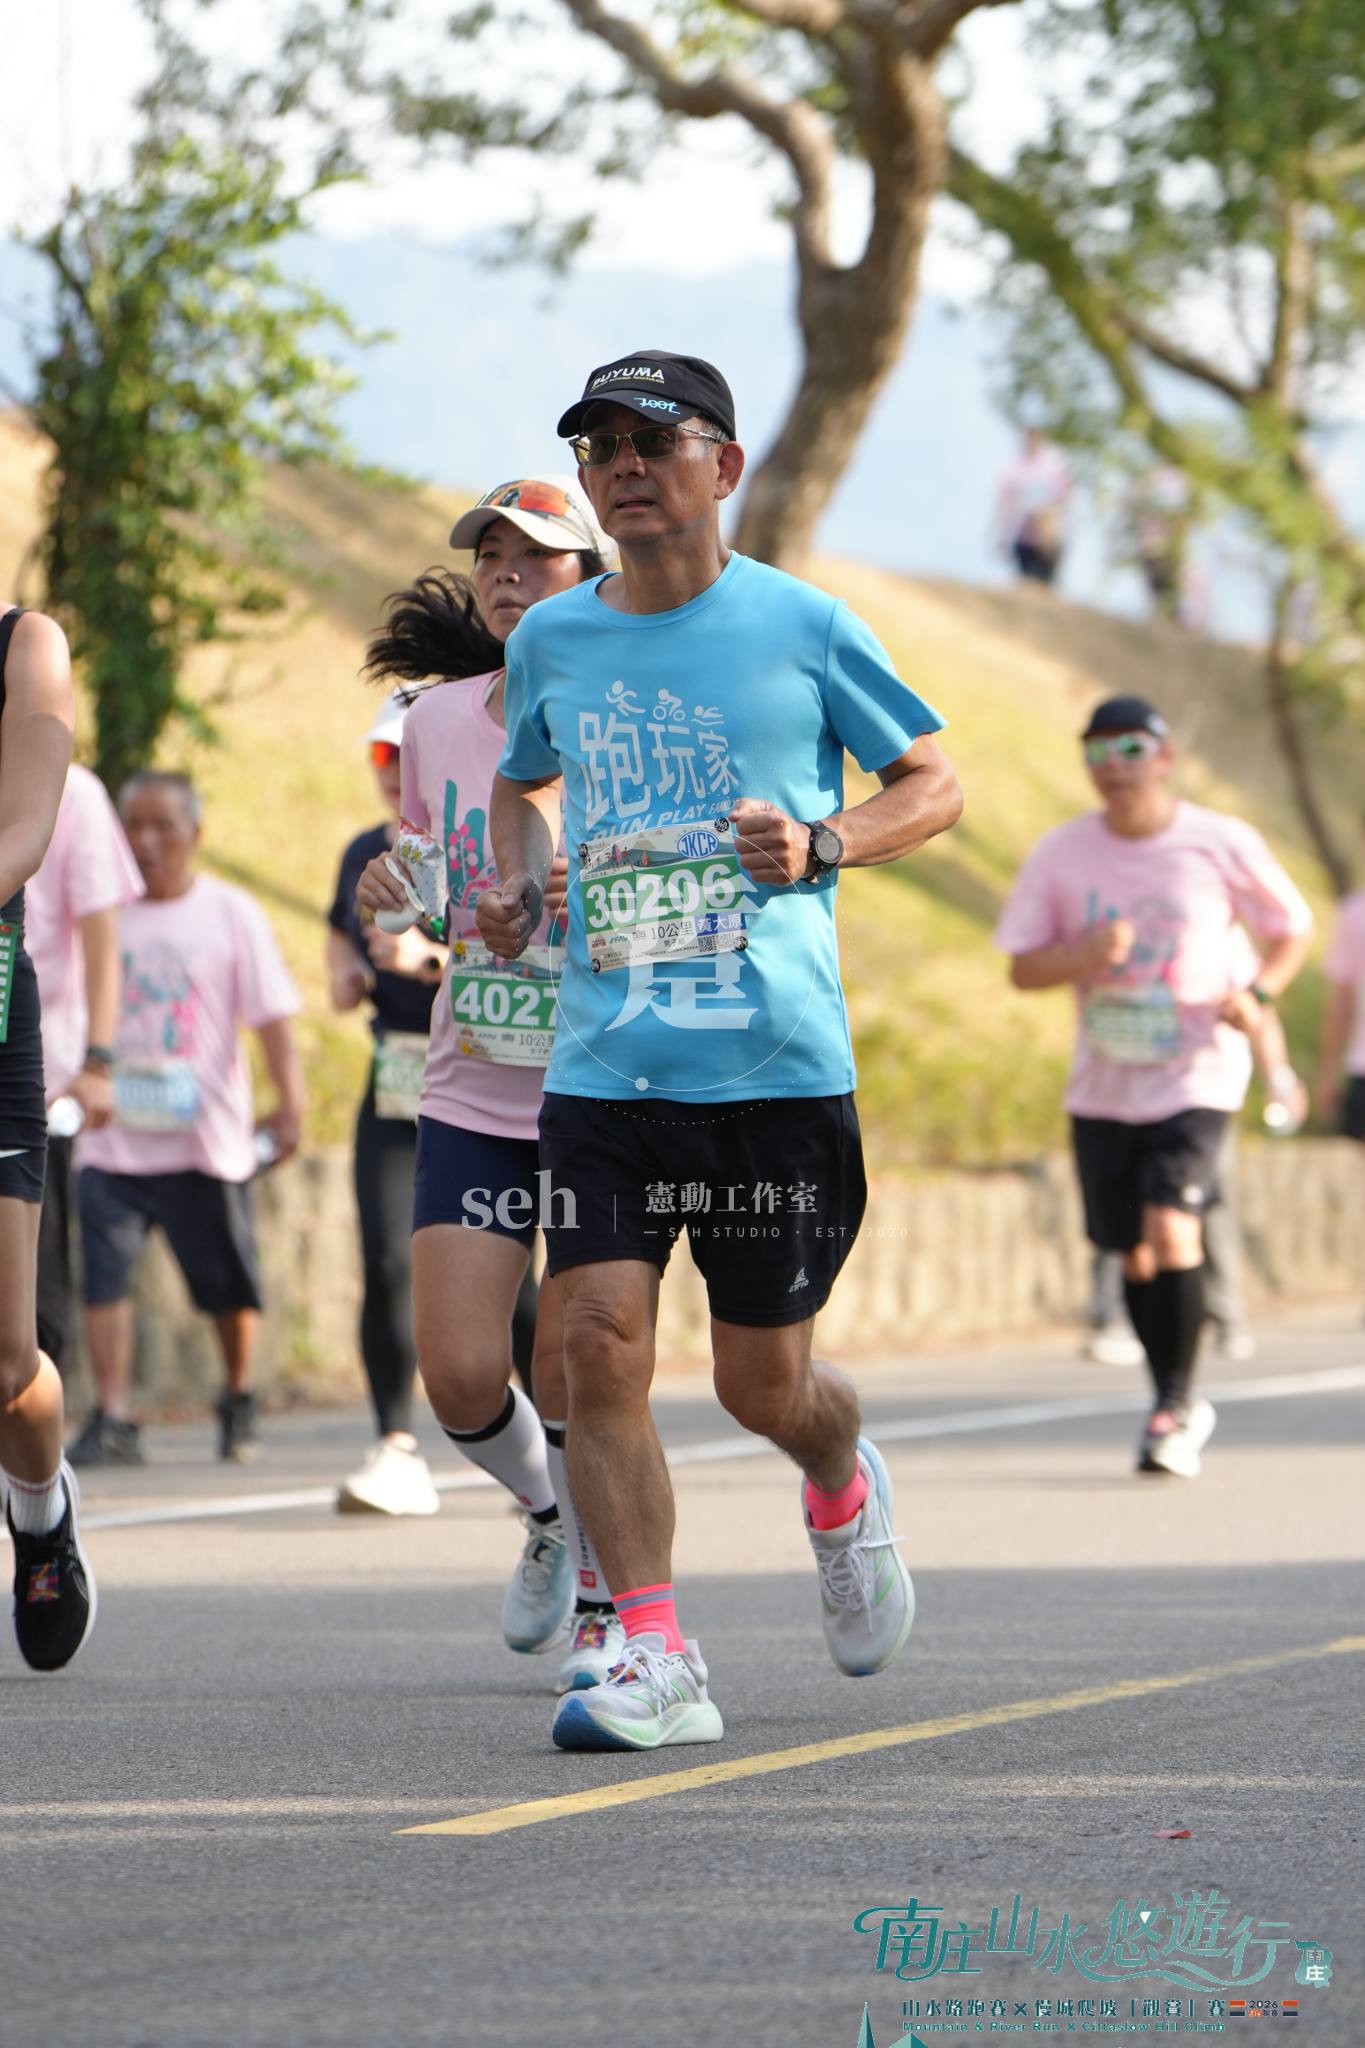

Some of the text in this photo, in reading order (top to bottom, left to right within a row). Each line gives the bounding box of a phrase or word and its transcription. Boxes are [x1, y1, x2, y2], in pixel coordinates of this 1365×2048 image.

[591, 367, 665, 388] PUYUMA
[578, 711, 740, 832] 跑玩家
[656, 803, 706, 829] PLAY
[586, 863, 736, 929] 30206
[651, 919, 695, 940] 10公里
